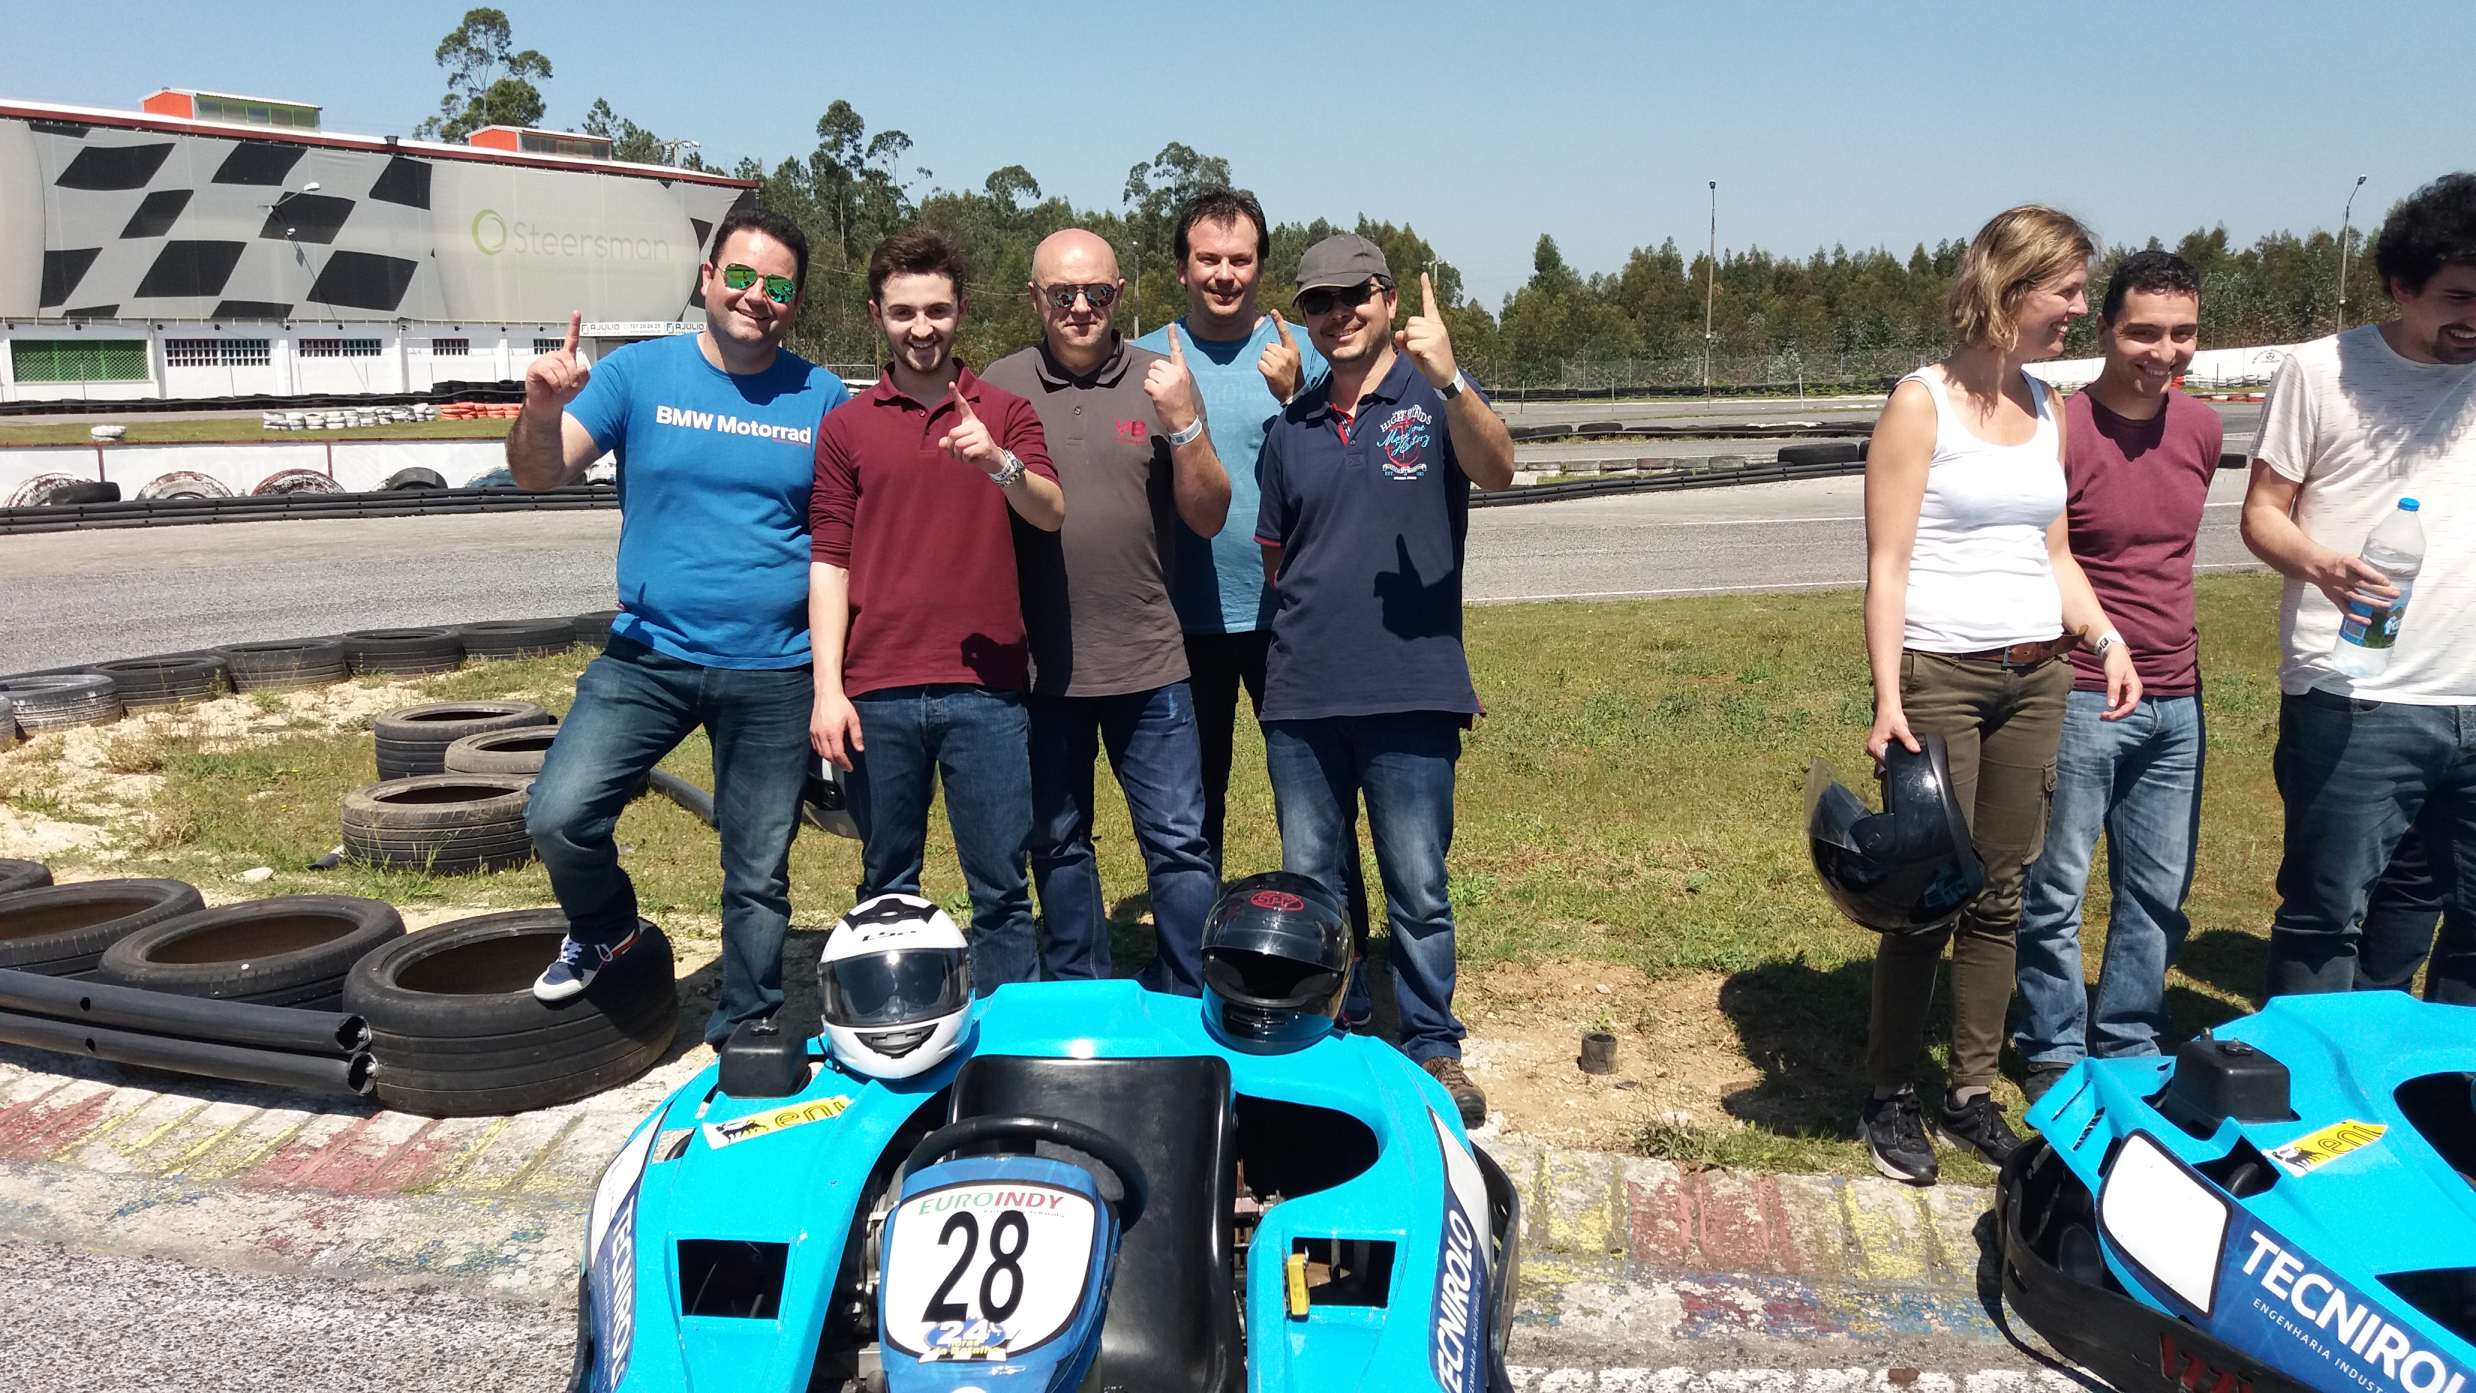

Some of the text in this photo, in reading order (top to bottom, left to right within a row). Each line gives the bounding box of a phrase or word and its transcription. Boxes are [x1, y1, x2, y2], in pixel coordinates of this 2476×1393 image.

[513, 221, 670, 261] Steersman
[655, 405, 813, 444] BMW Motorrad
[774, 1101, 846, 1128] eni
[2317, 1125, 2384, 1155] eni
[918, 1191, 1065, 1216] EUROINDY
[921, 1209, 1030, 1325] 28
[2252, 1297, 2331, 1361] ENGENHARIA
